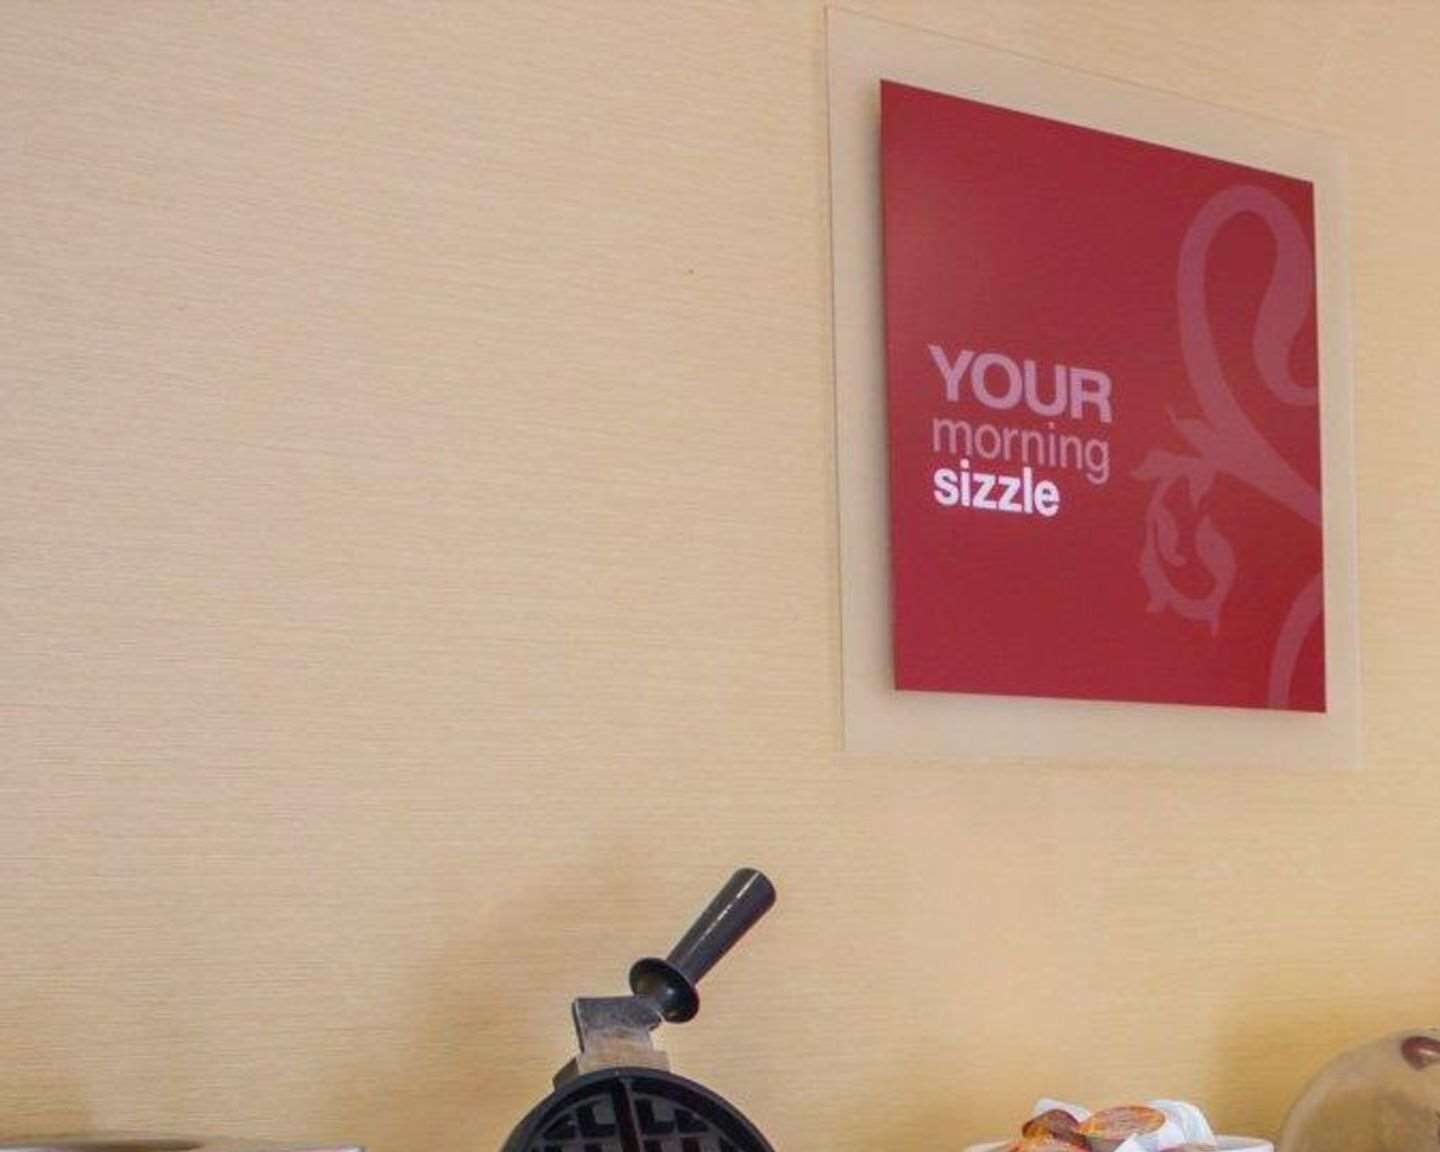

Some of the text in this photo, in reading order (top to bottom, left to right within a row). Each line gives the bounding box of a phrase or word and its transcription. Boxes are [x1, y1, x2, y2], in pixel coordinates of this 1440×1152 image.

[928, 344, 1113, 423] YOUR
[932, 418, 1110, 485] morning
[933, 458, 1060, 517] sizzle
